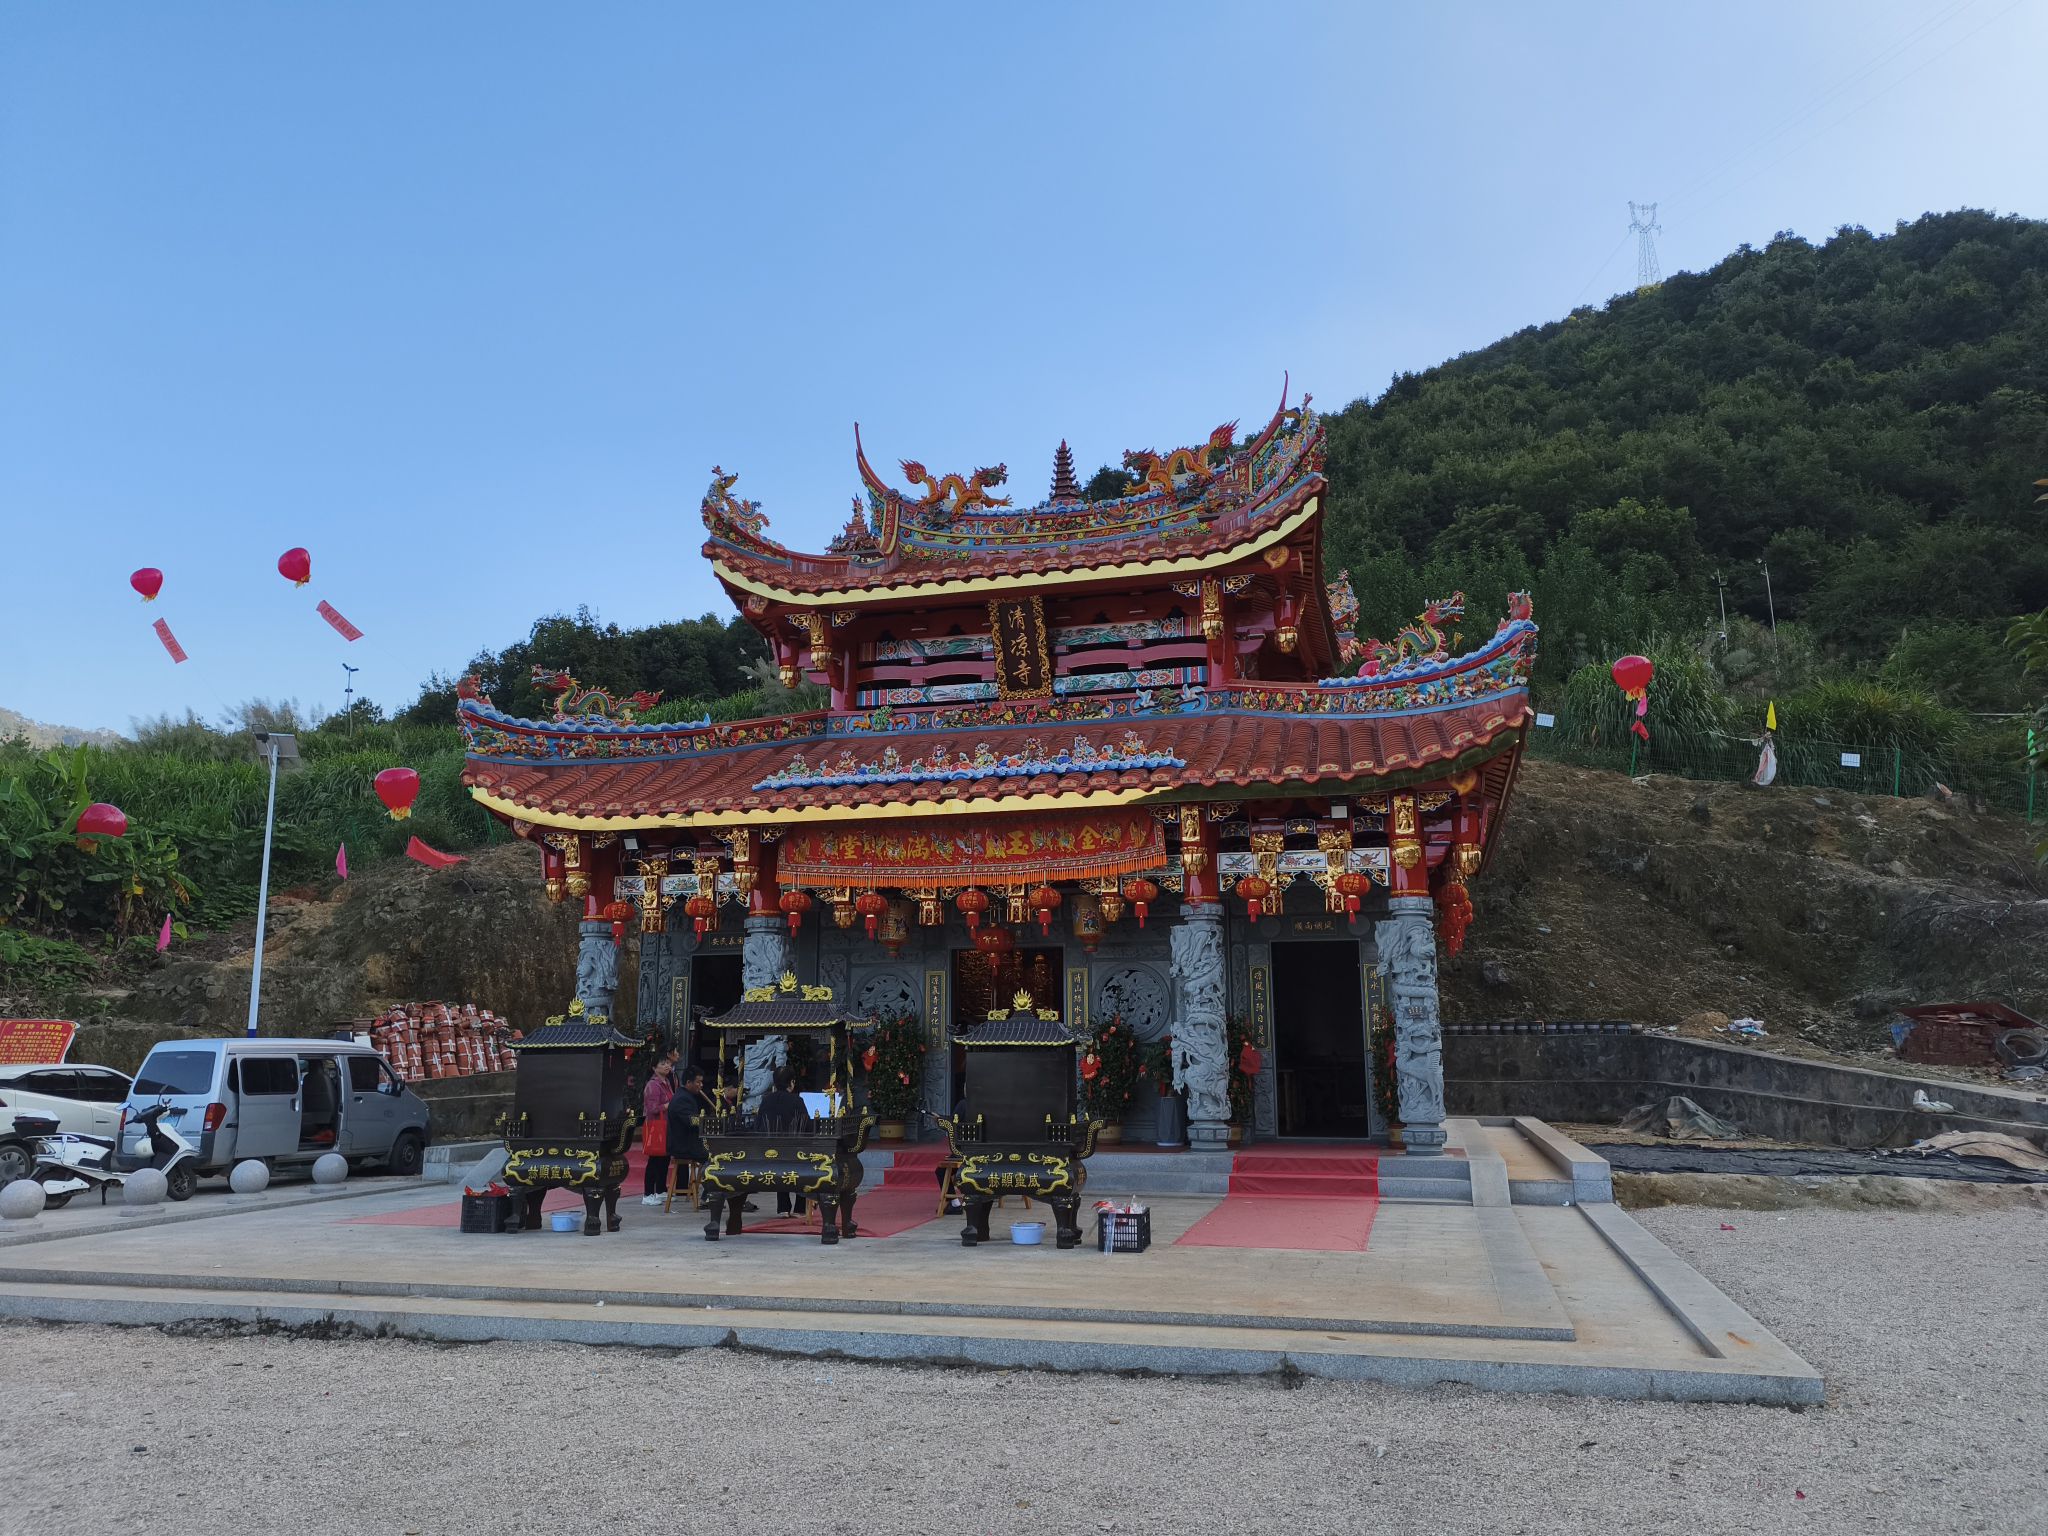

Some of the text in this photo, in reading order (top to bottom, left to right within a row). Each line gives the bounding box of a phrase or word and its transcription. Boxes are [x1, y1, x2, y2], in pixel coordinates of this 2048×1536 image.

[1008, 605, 1032, 686] 清凉寺
[736, 1170, 800, 1186] 清凉寺
